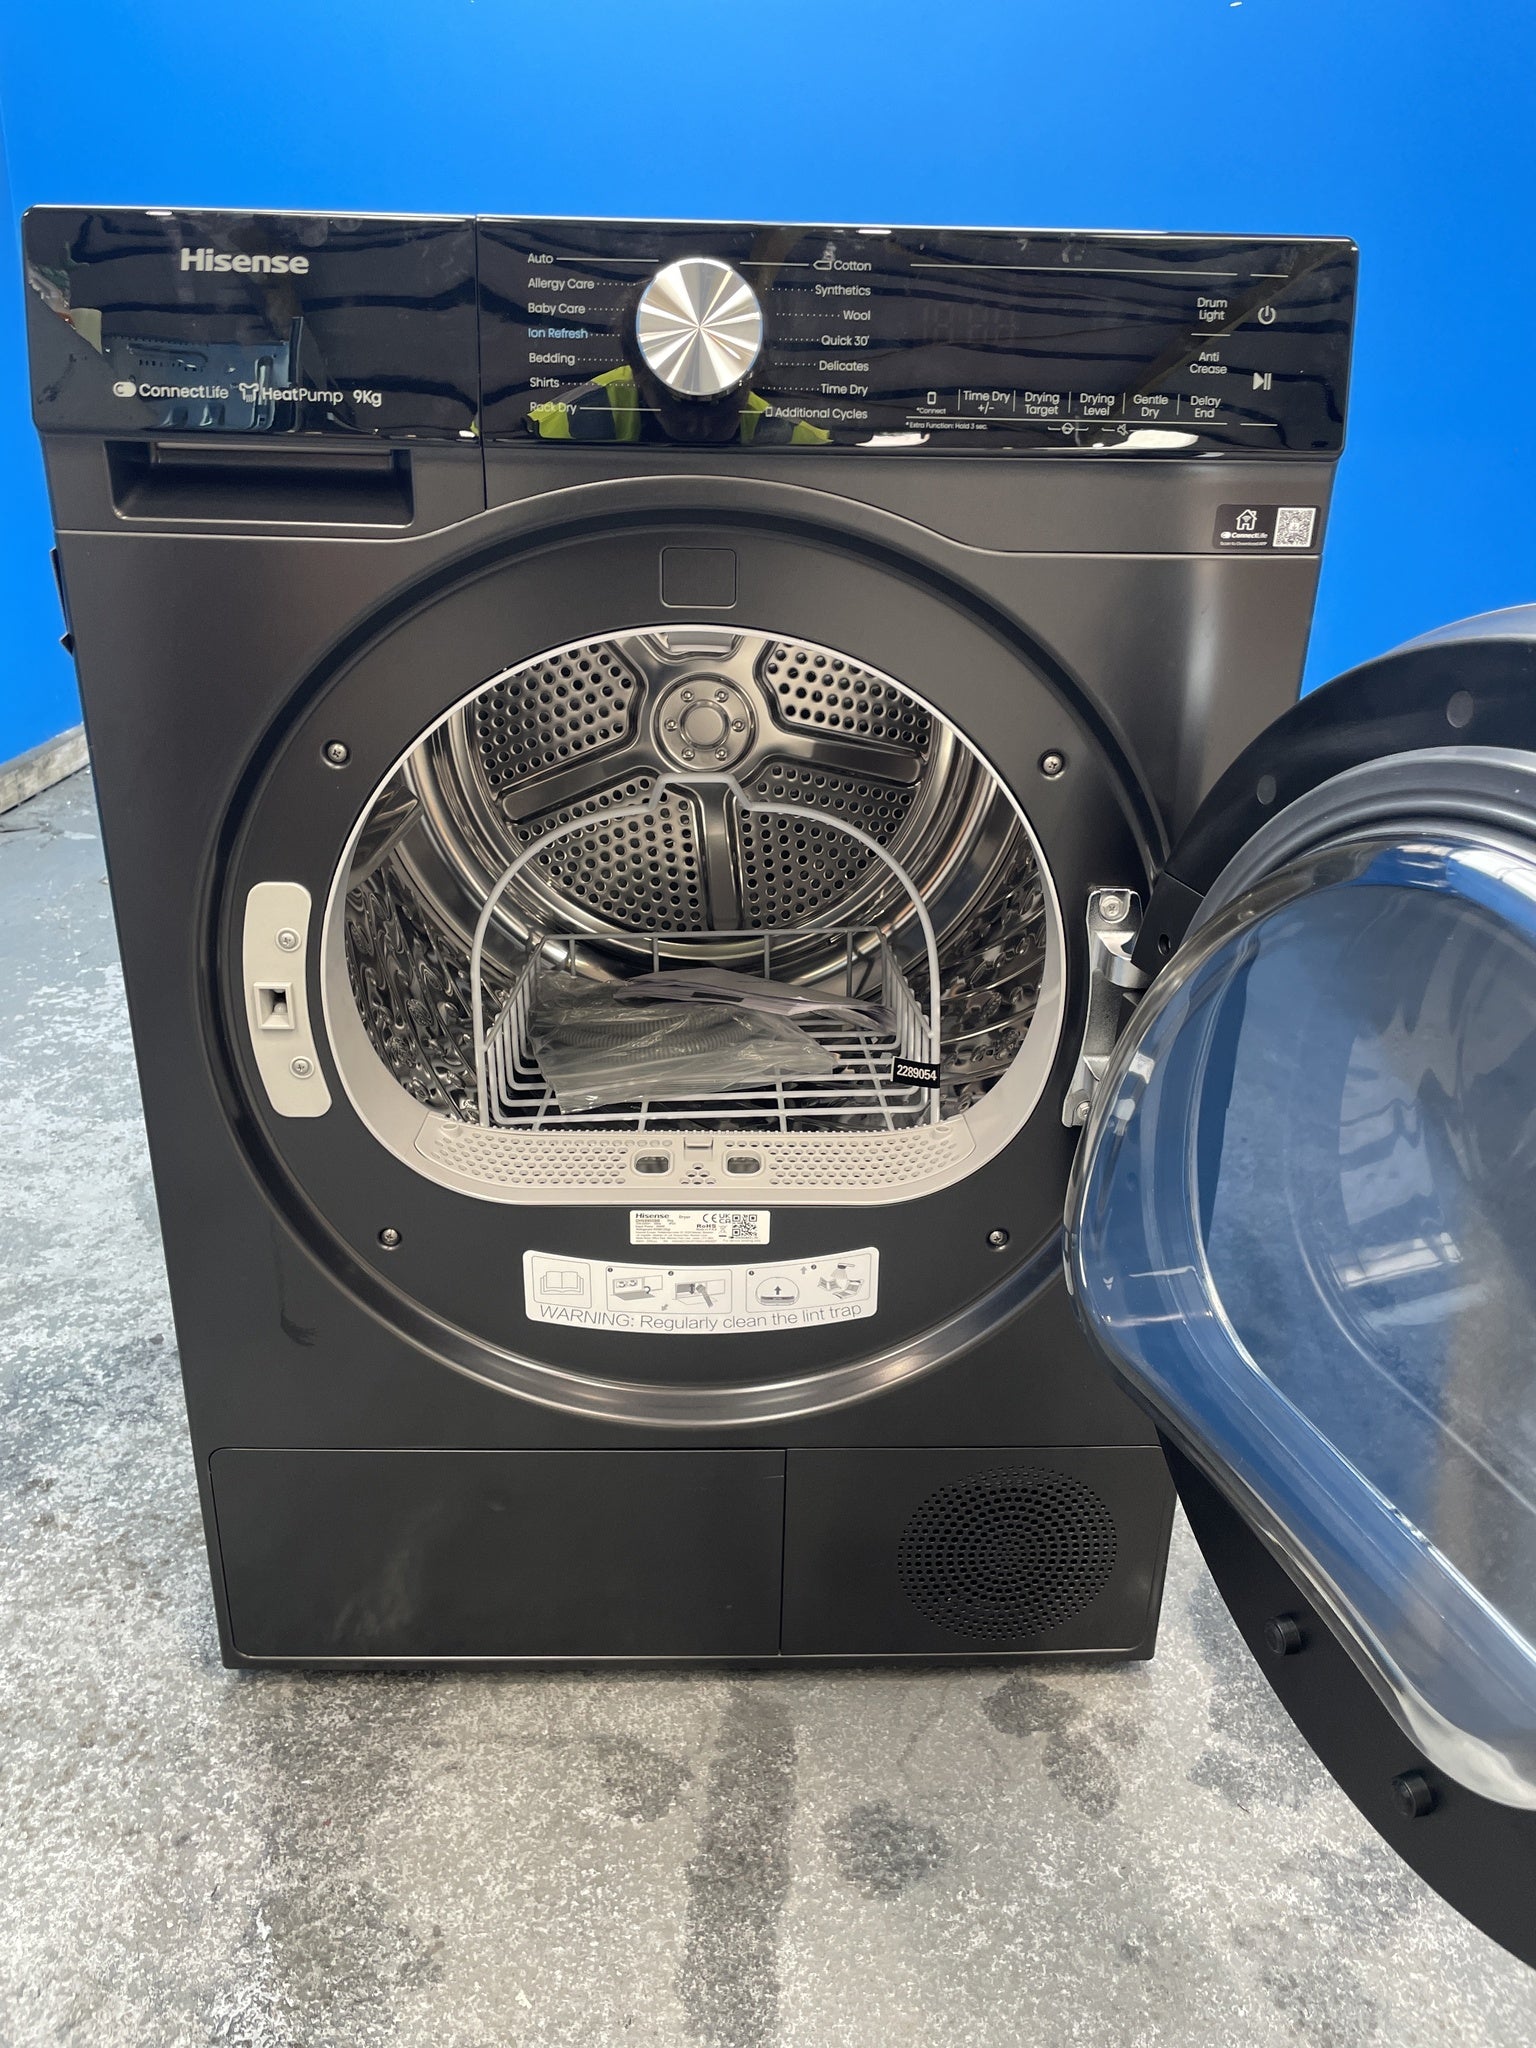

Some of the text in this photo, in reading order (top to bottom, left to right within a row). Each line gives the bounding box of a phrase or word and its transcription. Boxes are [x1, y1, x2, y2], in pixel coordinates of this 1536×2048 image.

[180, 248, 309, 275] Hisense
[527, 253, 554, 264] Auto
[833, 260, 872, 271] Cotton
[527, 278, 595, 291] Allergy Care
[815, 284, 871, 297] Synthetics
[527, 302, 586, 316] Baby Care
[1197, 297, 1228, 308] Drum
[843, 310, 871, 320] Wool
[1198, 309, 1226, 322] Light
[527, 328, 589, 339] Ion Refresh
[820, 335, 852, 346] Quick
[528, 352, 576, 366] Bedding
[1198, 352, 1220, 362] Anti
[819, 360, 869, 371] Delicates
[1189, 363, 1228, 374] Crease
[529, 377, 560, 388] Shirts
[139, 383, 229, 399] ConnectLife
[820, 383, 869, 397] Time Dry
[262, 387, 382, 407] HeatPump 9Kg
[963, 390, 1011, 404] Time Dry
[1025, 392, 1060, 405] Drying
[1080, 393, 1115, 406] Drying
[1133, 394, 1169, 405] Gentle
[1190, 396, 1221, 408] Delay
[530, 402, 578, 415] Rack Dry
[775, 407, 868, 420] Additional Cycles
[1025, 405, 1059, 417] Target
[1083, 405, 1110, 416] Level
[1141, 406, 1160, 419] Dry
[1194, 409, 1215, 418] End
[896, 1064, 938, 1081] 2289054
[540, 1304, 862, 1331] WARNING: Regularly clean the lint trap
